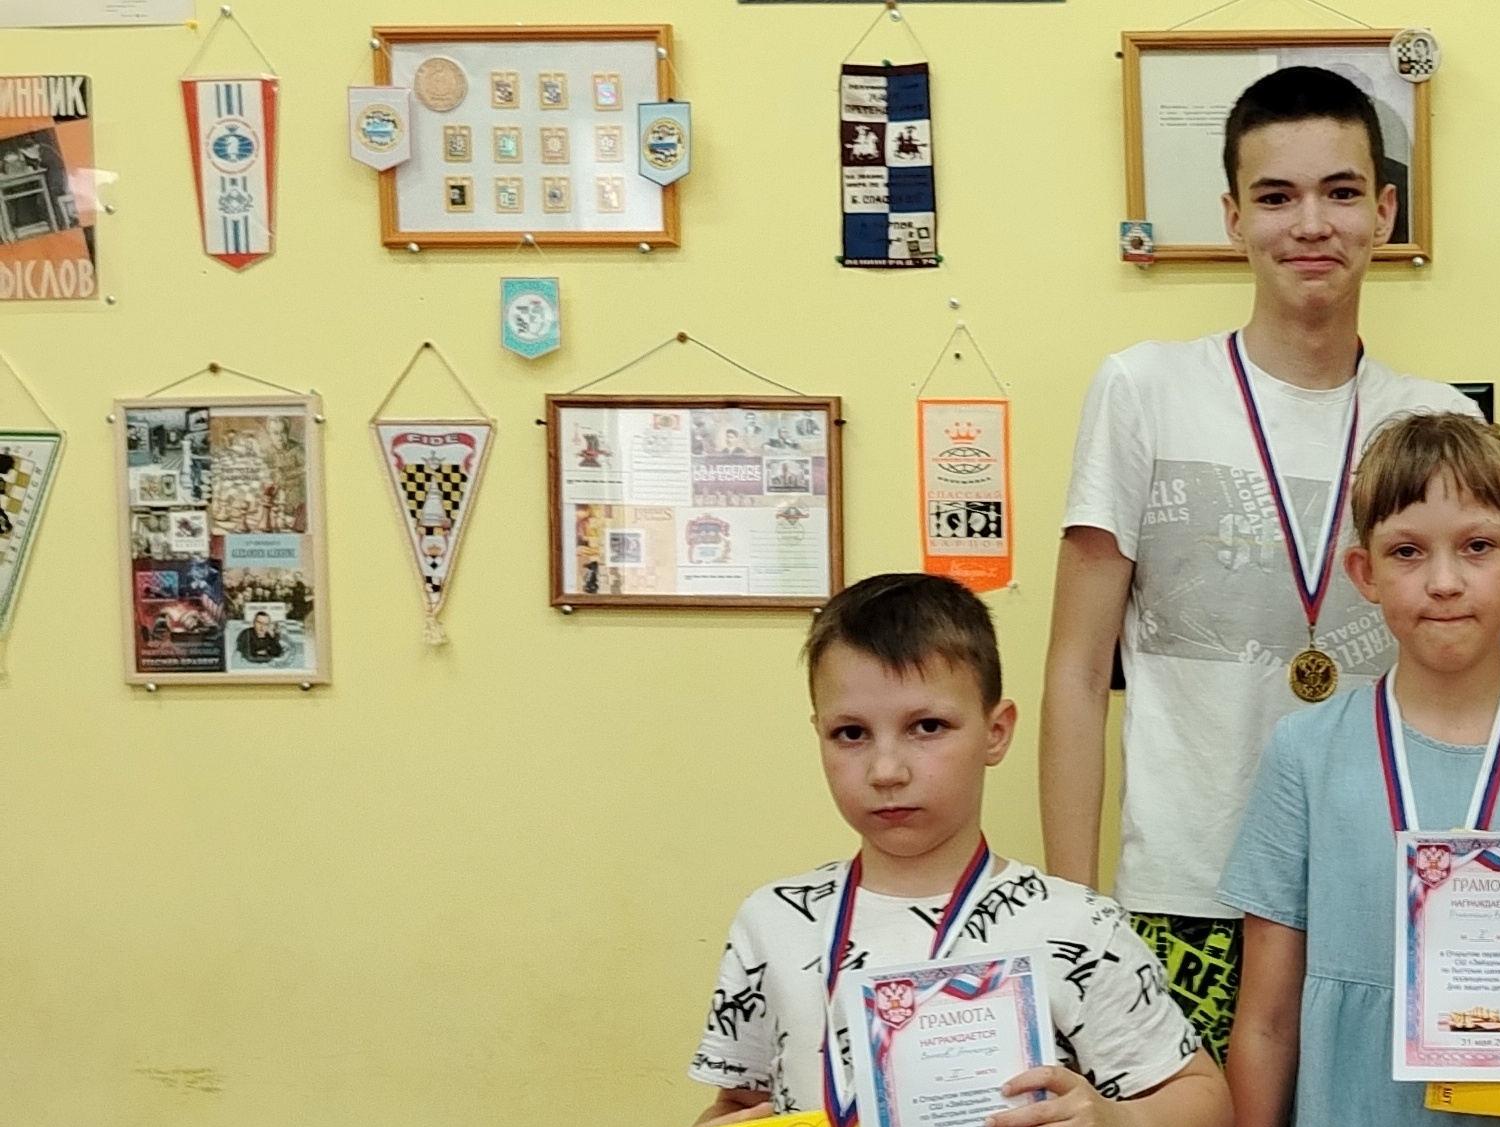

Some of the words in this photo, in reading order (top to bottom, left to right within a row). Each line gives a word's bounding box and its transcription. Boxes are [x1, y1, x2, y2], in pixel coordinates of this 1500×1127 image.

[406, 433, 459, 445] FIDE
[918, 1007, 997, 1030] ГРАМОТА
[919, 1029, 997, 1048] НАГРАЖДАЕТСЯ
[1460, 1038, 1474, 1047] 31
[1474, 1039, 1492, 1047] мая
[919, 1092, 959, 1105] Открытом
